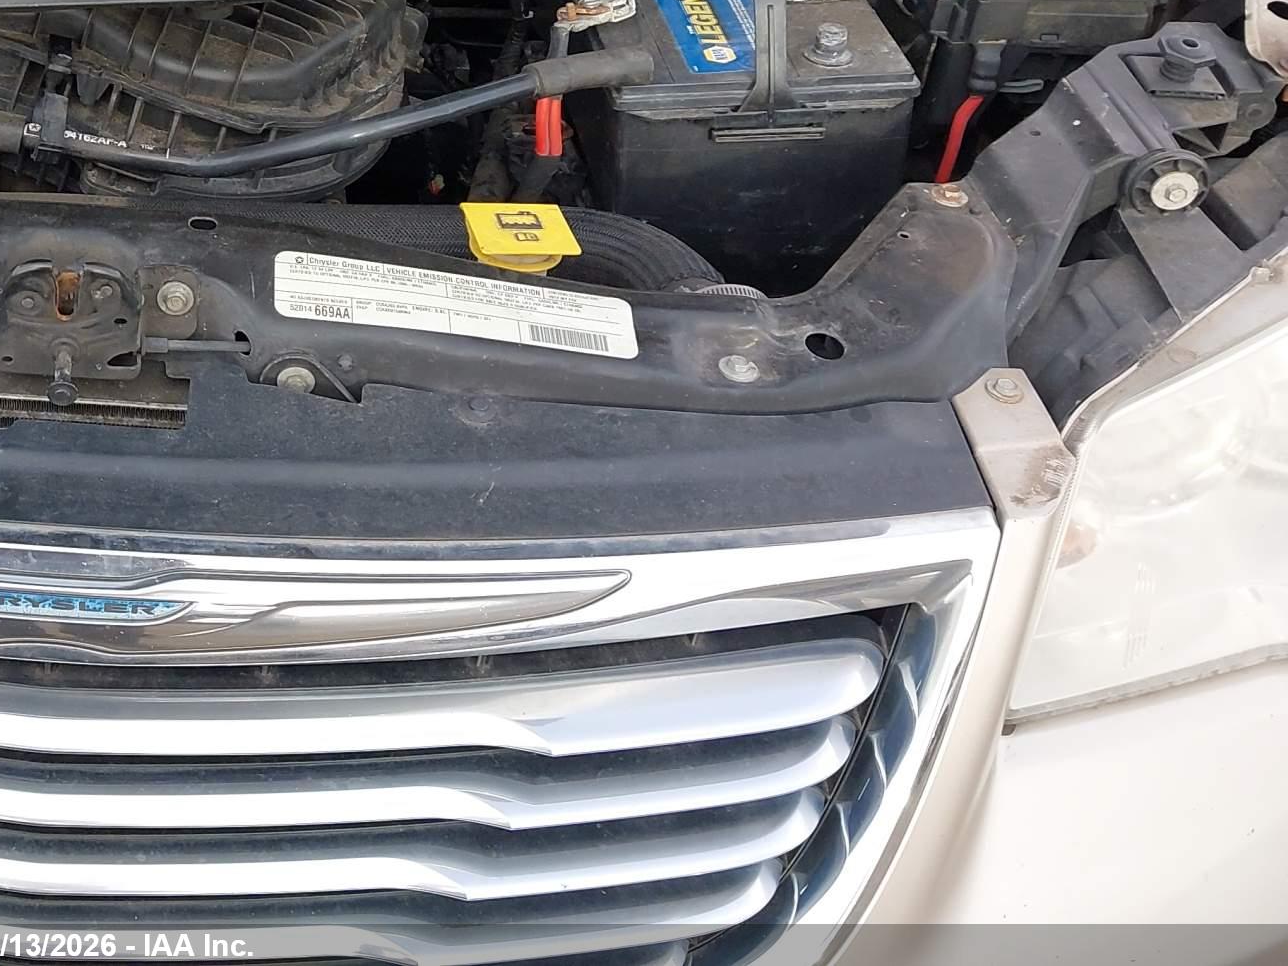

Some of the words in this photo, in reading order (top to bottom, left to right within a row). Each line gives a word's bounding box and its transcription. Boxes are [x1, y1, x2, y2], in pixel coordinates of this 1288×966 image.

[309, 256, 340, 268] Chrysler
[341, 260, 364, 272] Group
[366, 262, 382, 273] LLC
[386, 266, 416, 278] VEHICLE
[418, 271, 454, 283] EMISSION
[456, 277, 489, 290] CONTROL
[491, 280, 541, 296] INFORMATION
[314, 304, 351, 320] 669AA
